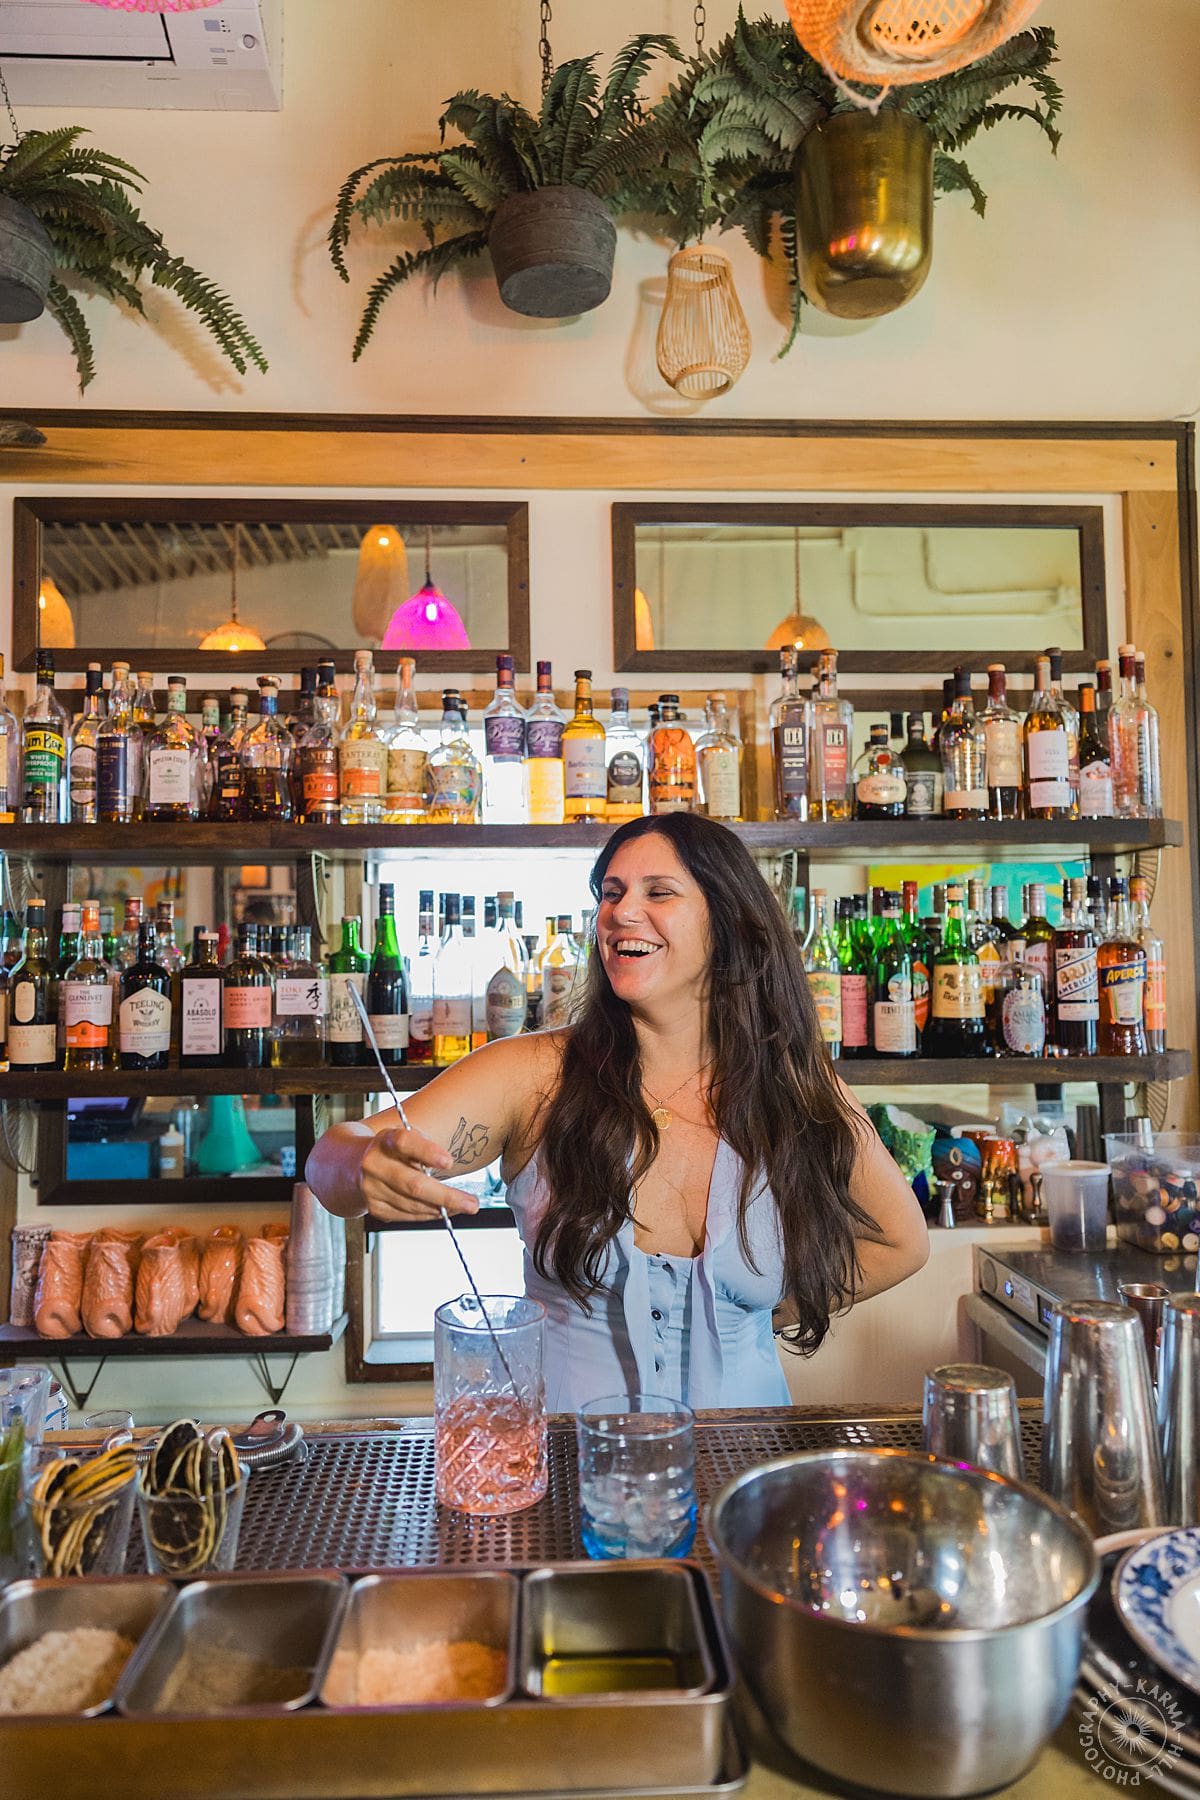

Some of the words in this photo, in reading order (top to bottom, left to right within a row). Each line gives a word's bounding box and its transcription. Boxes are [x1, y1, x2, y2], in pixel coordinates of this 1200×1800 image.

[1106, 965, 1145, 984] APEROL
[129, 999, 165, 1012] TEELING
[132, 1018, 160, 1027] WHISKEY
